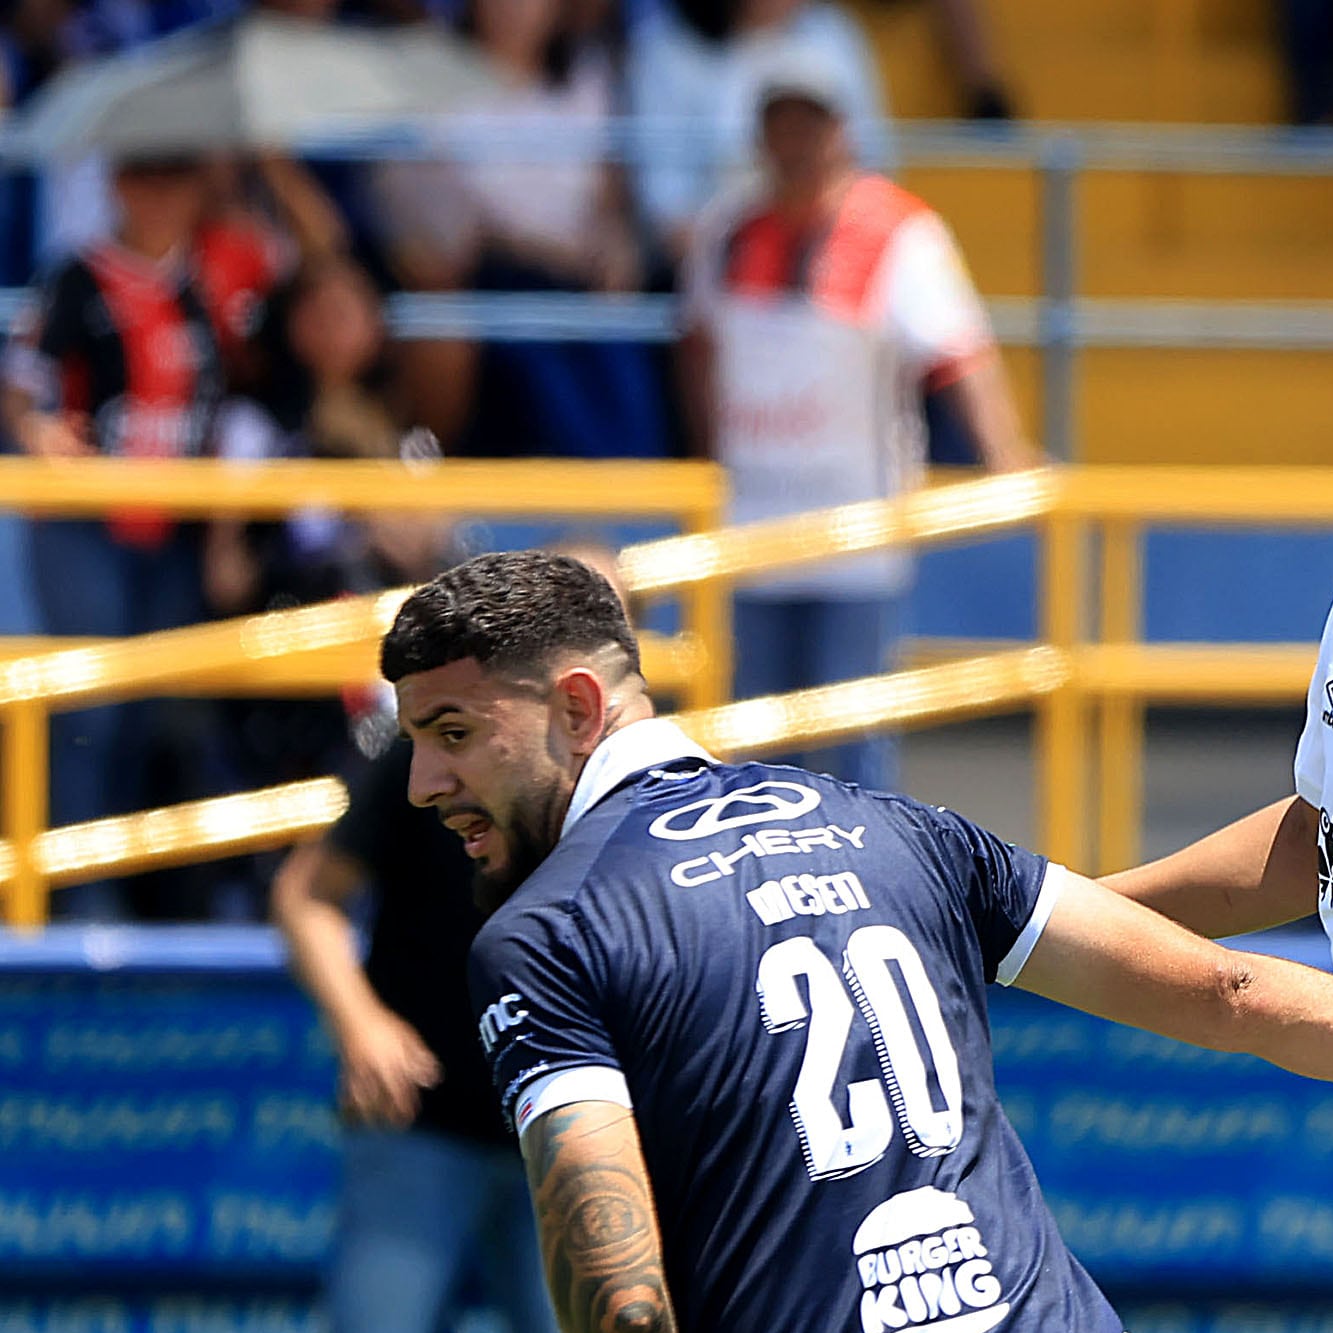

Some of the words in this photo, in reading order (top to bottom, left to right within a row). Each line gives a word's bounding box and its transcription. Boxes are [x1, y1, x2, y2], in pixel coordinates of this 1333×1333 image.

[670, 824, 866, 888] CHERY
[757, 925, 963, 1182] 20
[857, 1226, 988, 1289] BURGER
